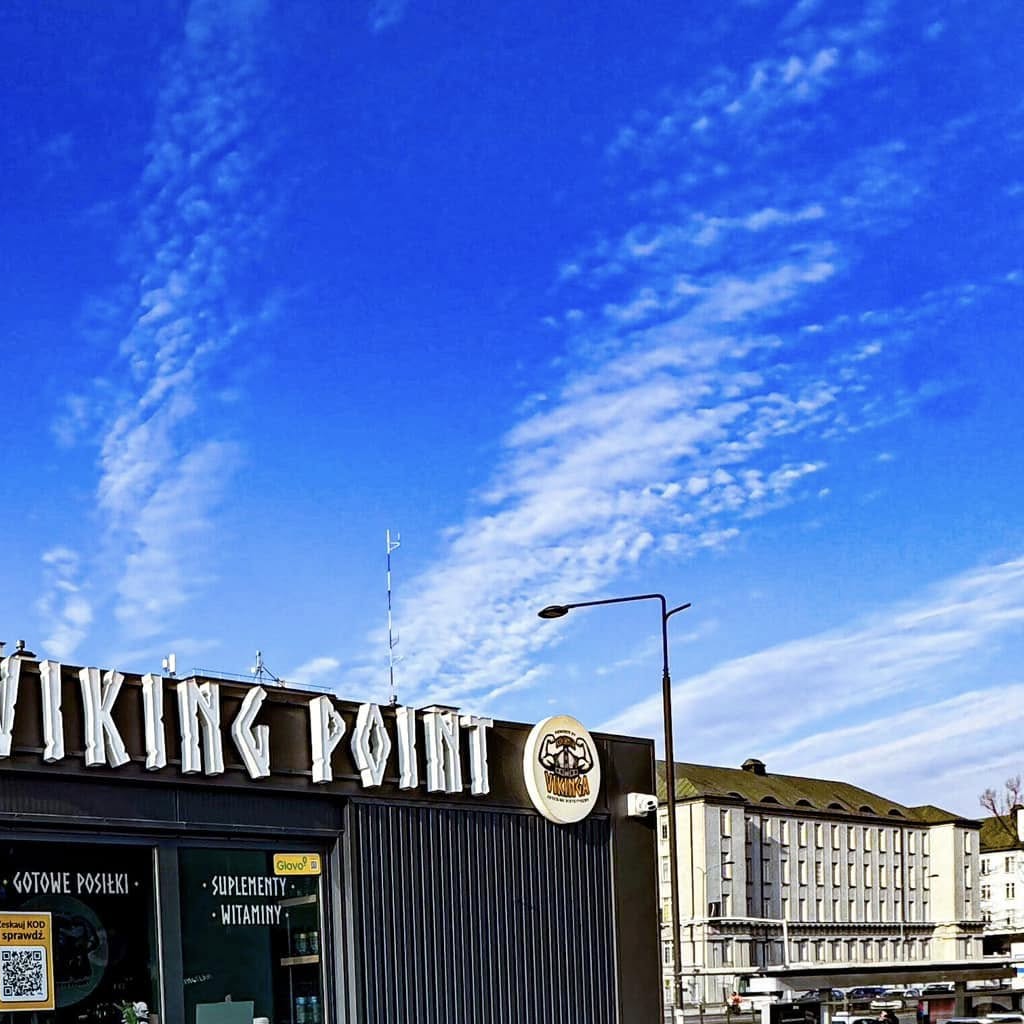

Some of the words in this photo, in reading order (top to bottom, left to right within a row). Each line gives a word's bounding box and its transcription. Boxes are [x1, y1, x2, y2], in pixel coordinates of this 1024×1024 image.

[309, 695, 494, 795] POINT
[13, 872, 71, 894] GOTOWE
[77, 873, 129, 894] POSIŁKI
[212, 875, 287, 896] SUPLEMENTY
[220, 904, 282, 925] WITAMINY
